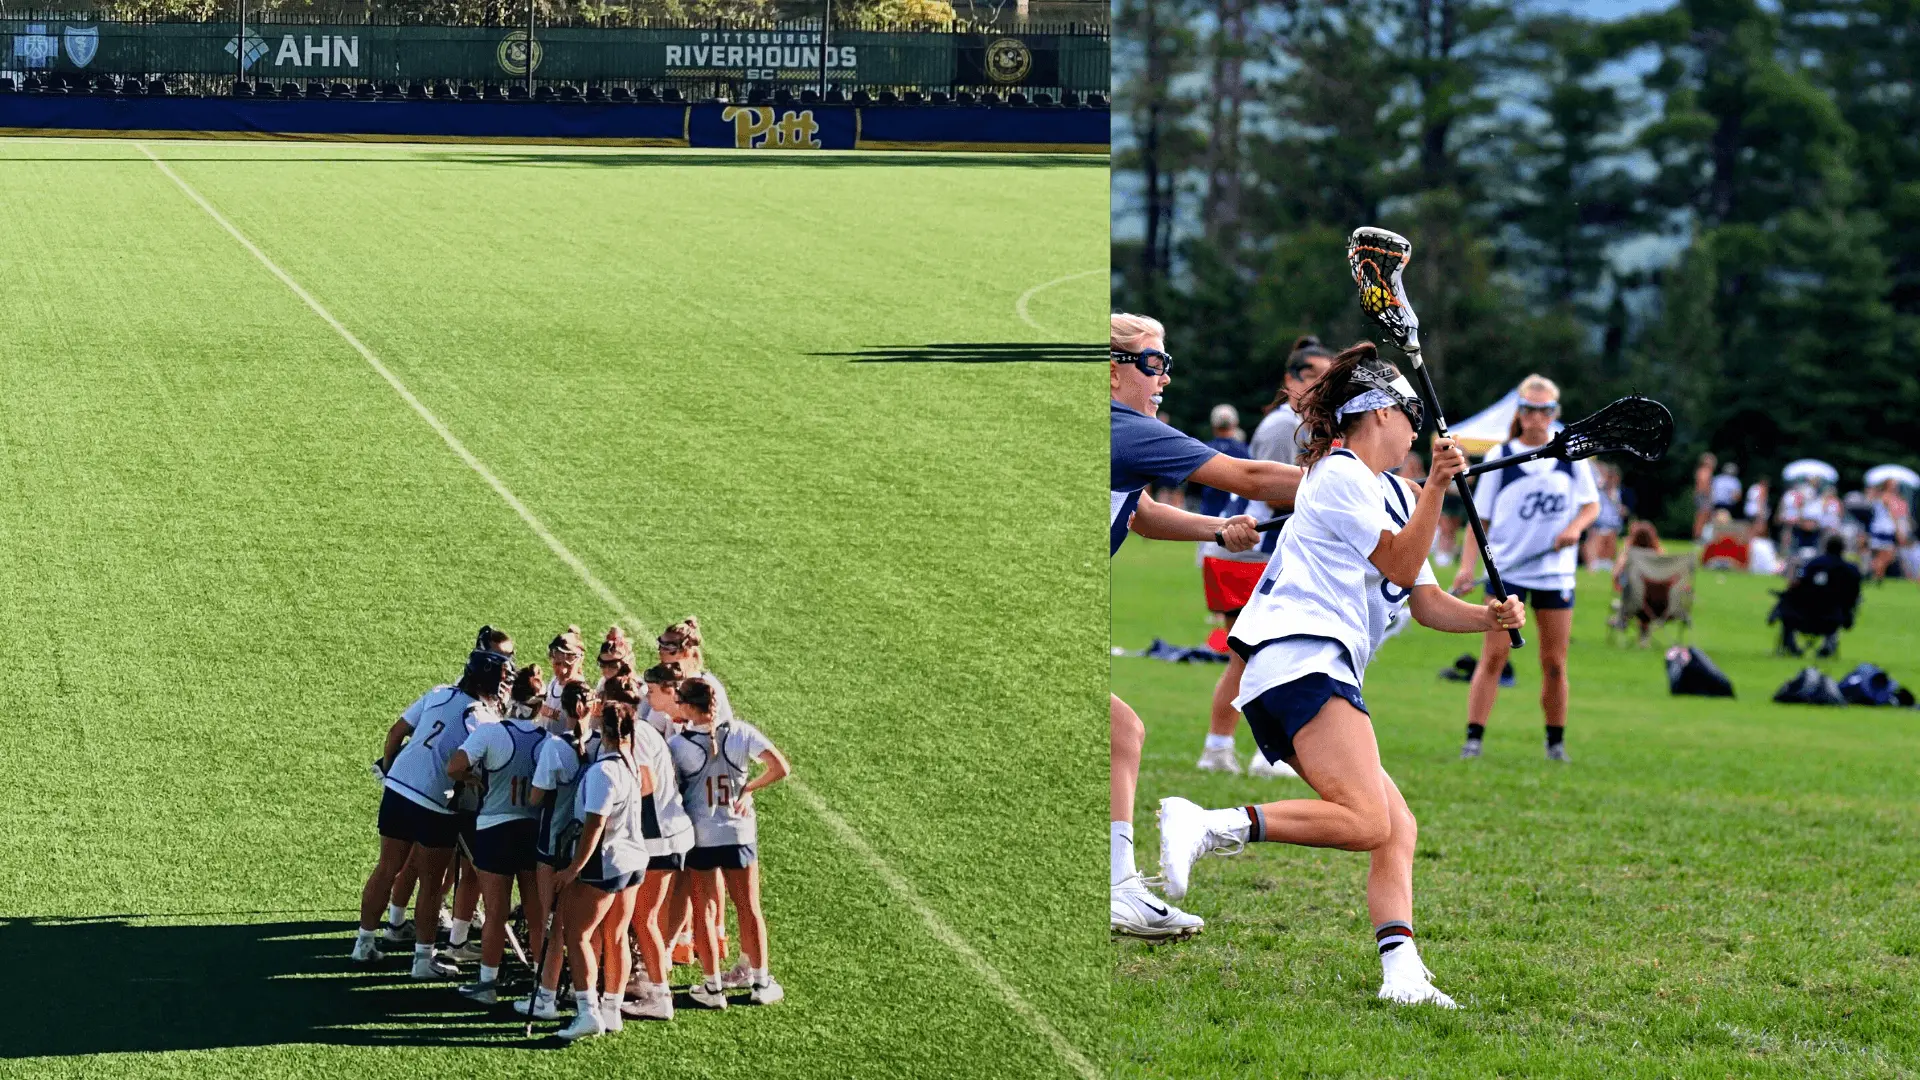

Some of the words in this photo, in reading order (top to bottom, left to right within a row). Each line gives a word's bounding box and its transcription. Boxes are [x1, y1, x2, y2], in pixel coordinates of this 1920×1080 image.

[275, 34, 359, 67] AHN
[701, 33, 822, 44] PITTSBURGH
[665, 45, 857, 67] RIVERHOUNDS
[747, 69, 774, 80] SC
[722, 105, 822, 148] Pitt
[1386, 385, 1406, 402] STX
[423, 720, 446, 750] 2
[705, 774, 730, 807] 15
